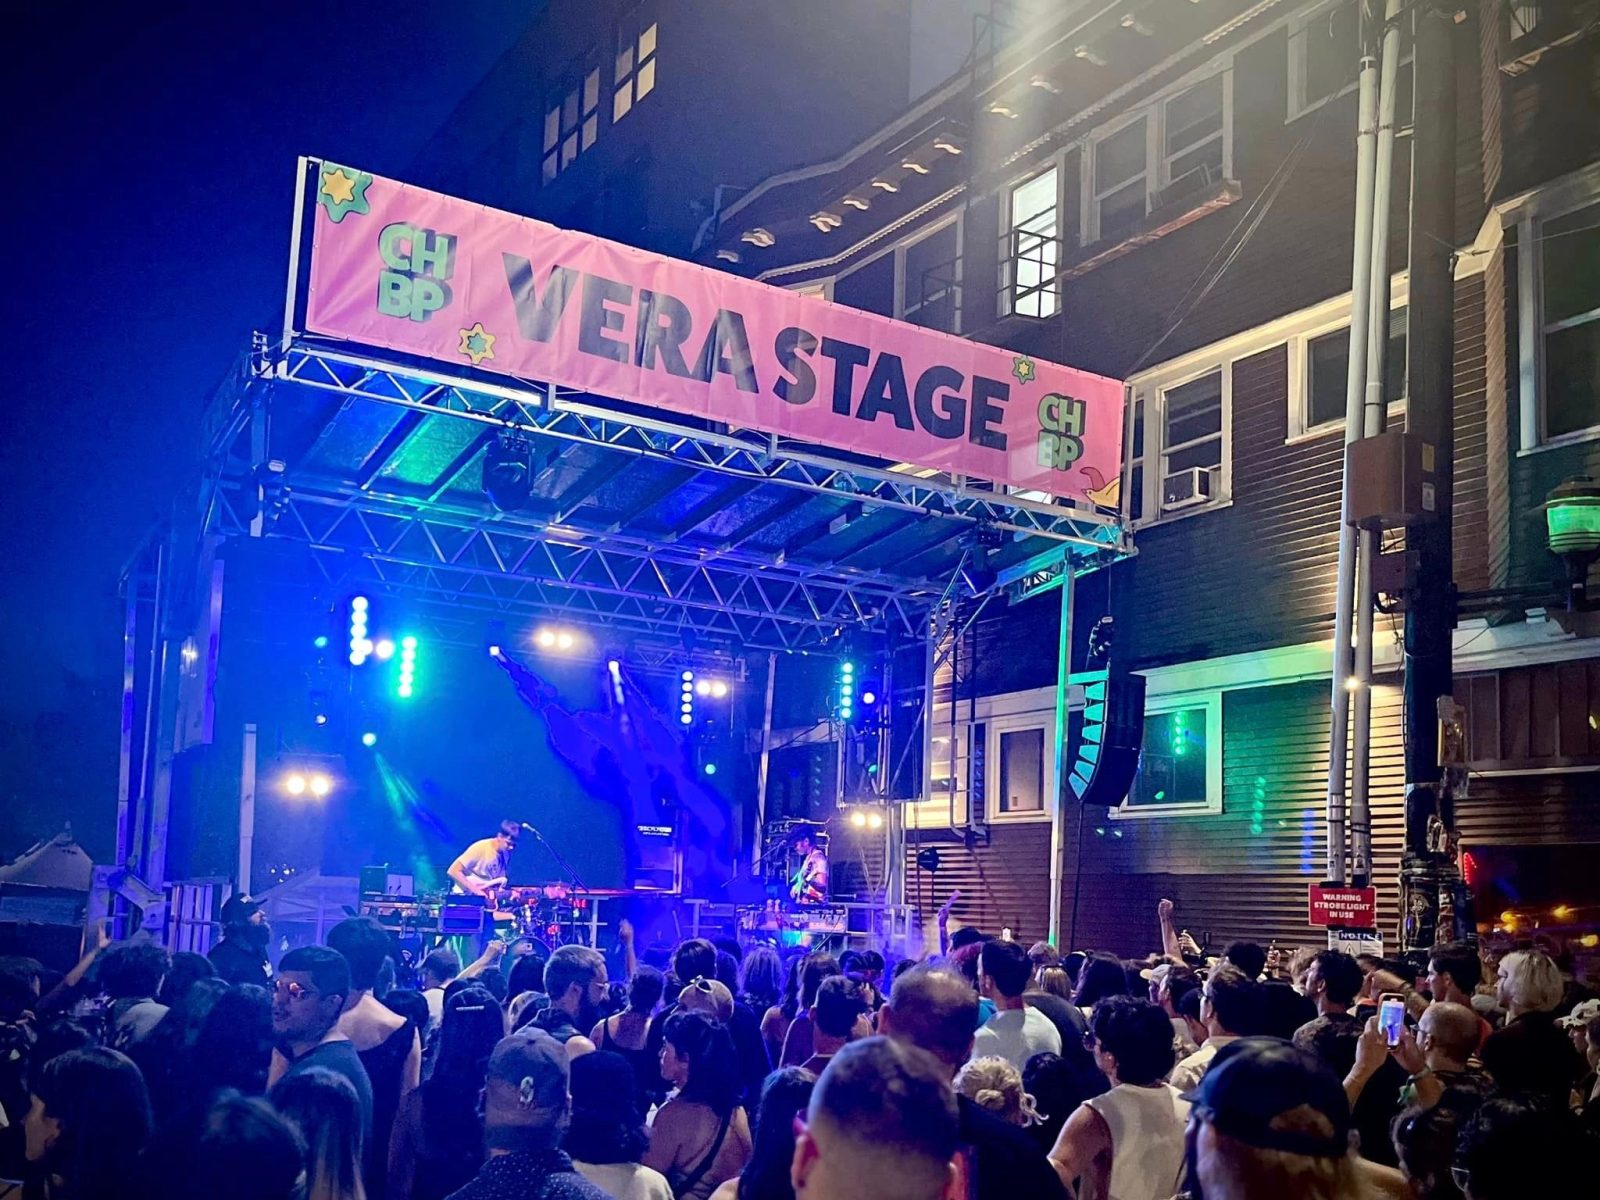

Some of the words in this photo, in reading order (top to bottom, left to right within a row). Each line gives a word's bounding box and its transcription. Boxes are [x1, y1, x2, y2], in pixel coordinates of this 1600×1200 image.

[378, 222, 456, 279] CH
[377, 267, 452, 322] BP
[502, 251, 759, 394] VERA
[772, 327, 1011, 452] STAGE
[1037, 392, 1085, 437] CH
[1037, 428, 1083, 471] BP
[1322, 893, 1361, 902] WARNING
[1339, 911, 1354, 919] USE
[1346, 903, 1370, 911] LIGHT
